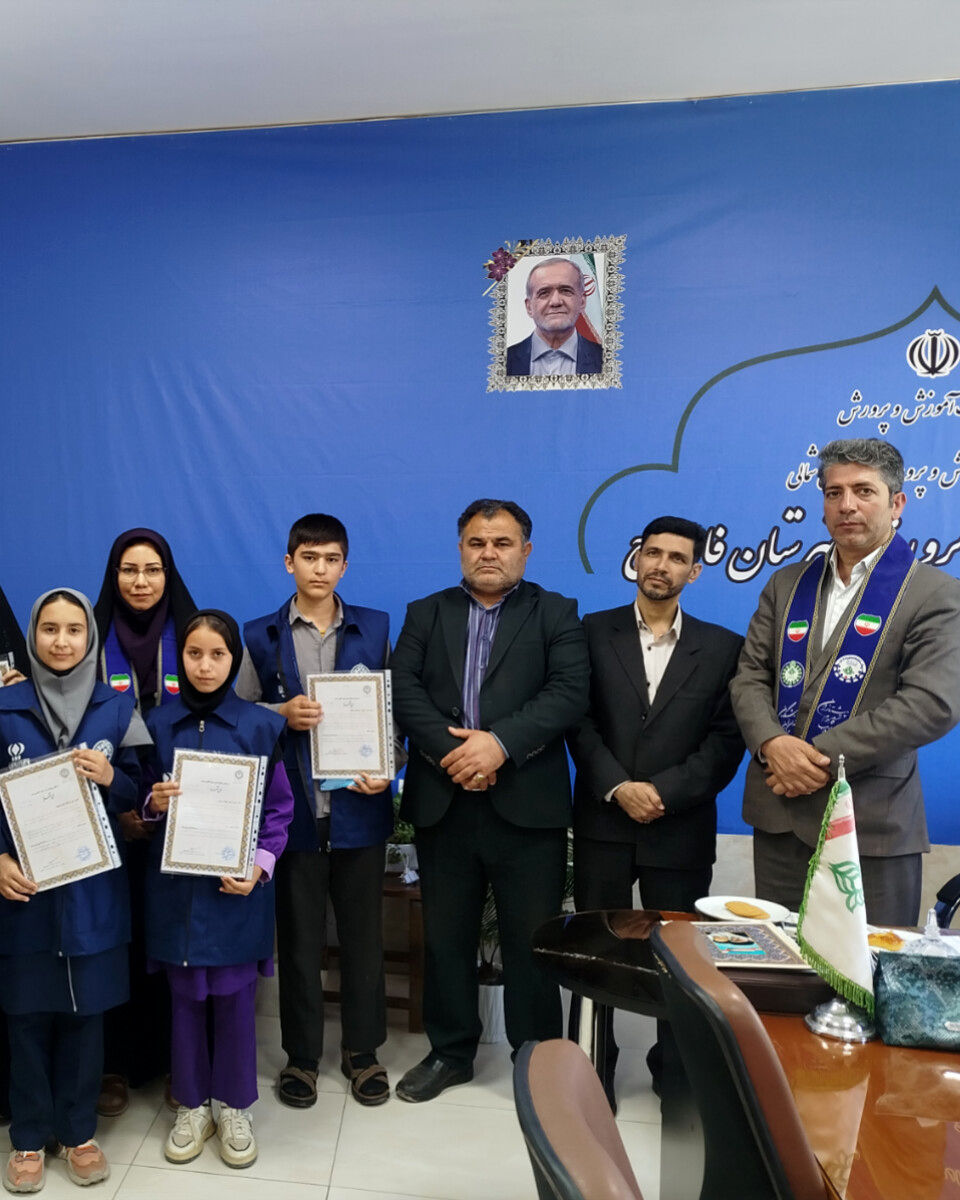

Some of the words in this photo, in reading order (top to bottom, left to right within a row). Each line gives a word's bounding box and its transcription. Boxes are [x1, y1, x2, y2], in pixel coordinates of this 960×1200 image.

[837, 389, 892, 435] پرورش
[890, 404, 902, 418] و
[927, 466, 940, 482] و
